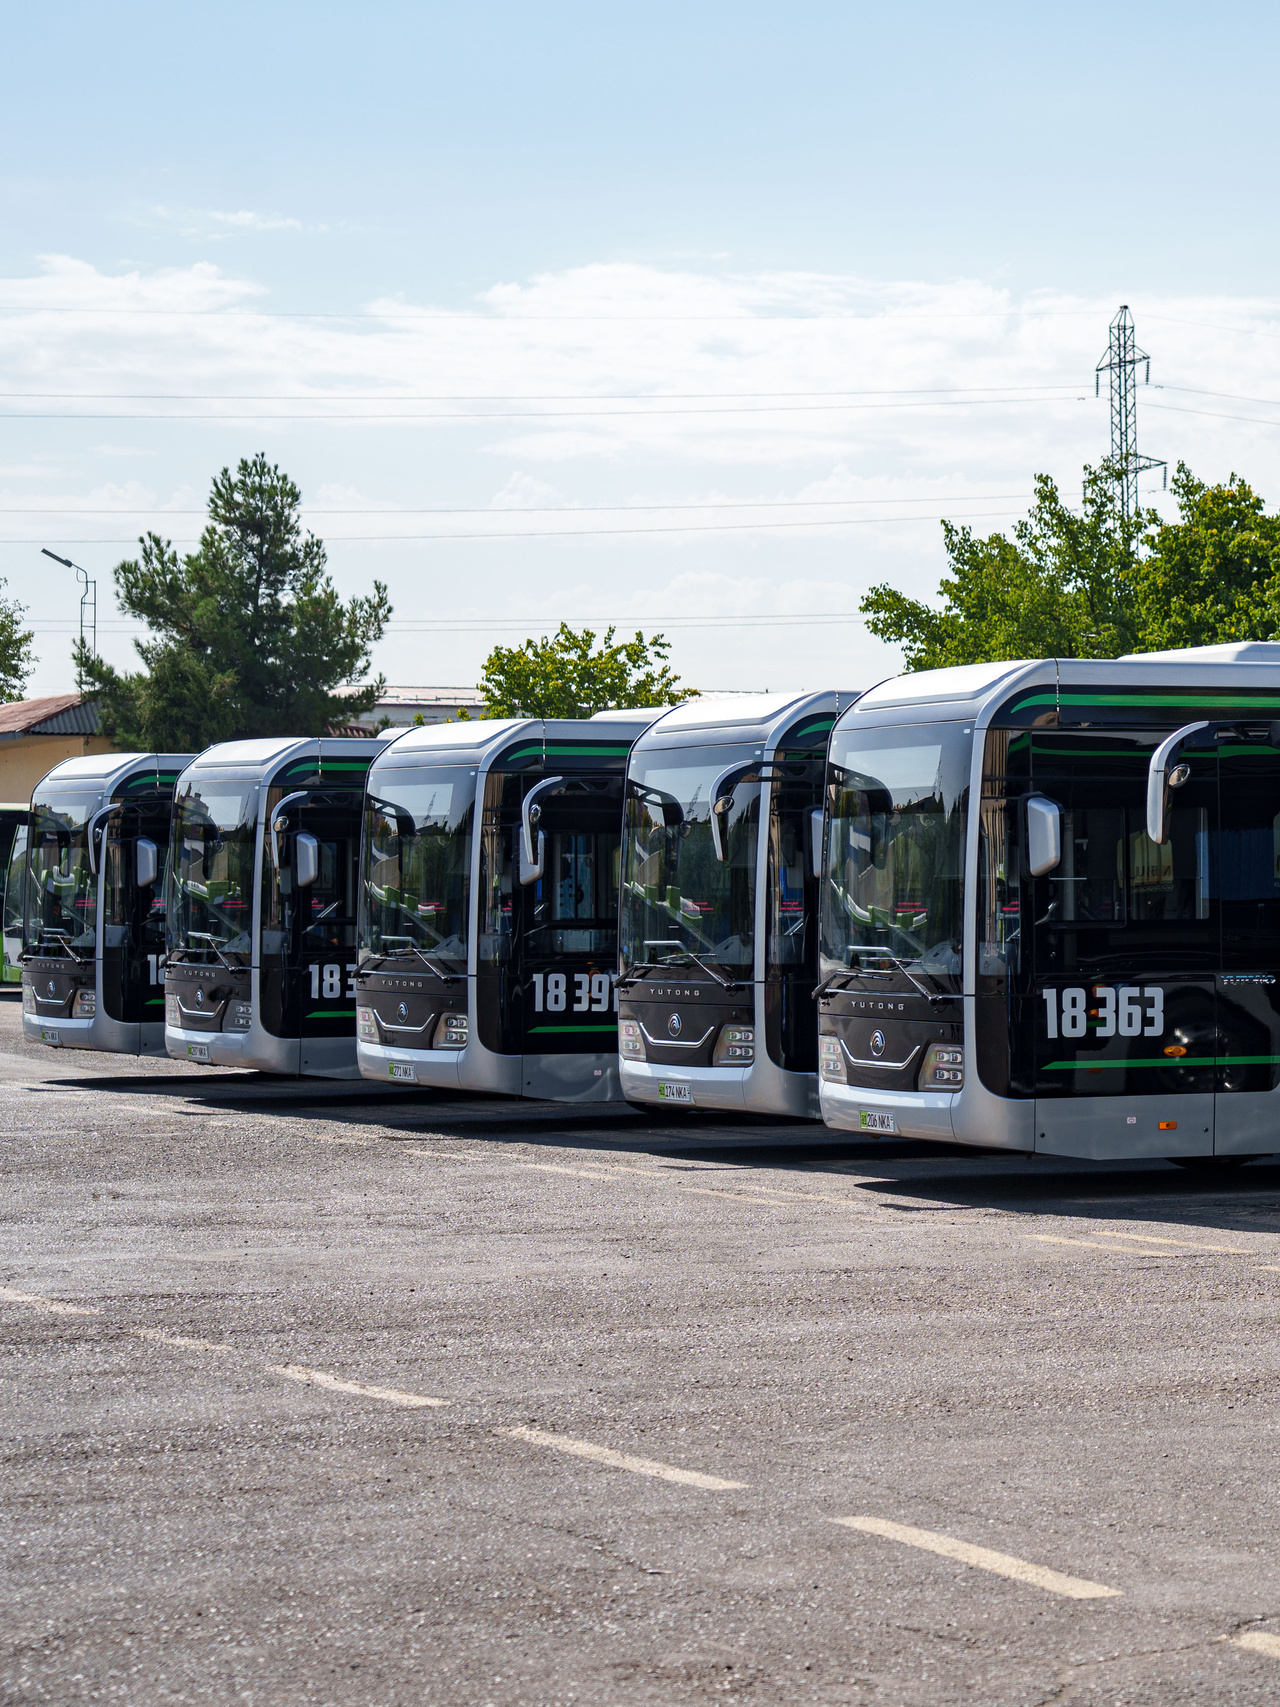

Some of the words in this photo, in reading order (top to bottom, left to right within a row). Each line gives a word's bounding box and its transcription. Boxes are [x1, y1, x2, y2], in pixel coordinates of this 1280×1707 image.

[183, 970, 216, 978] YUTONG
[309, 963, 341, 999] 18
[381, 979, 423, 988] YUTONG
[532, 973, 566, 1011] 18
[650, 988, 700, 996] YUTONG
[851, 1000, 905, 1011] YUTONG
[1042, 987, 1087, 1038] 18
[1095, 986, 1164, 1037] 363
[665, 1085, 674, 1098] 174
[675, 1086, 687, 1099] NKA
[878, 1114, 890, 1130] NKA
